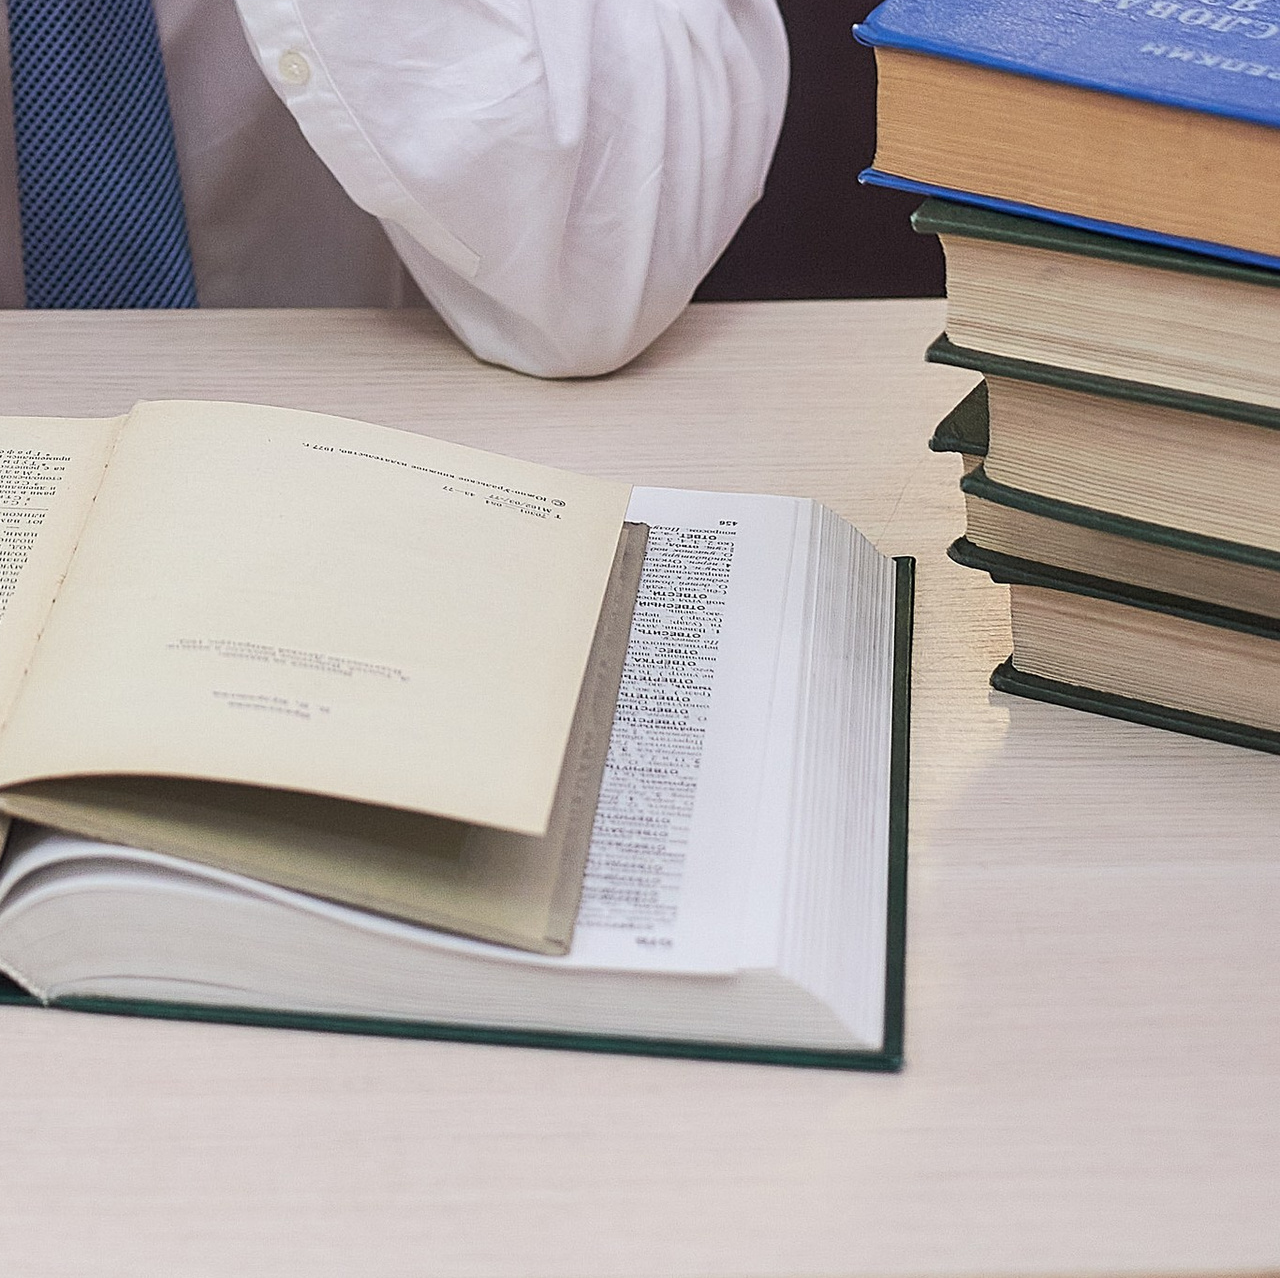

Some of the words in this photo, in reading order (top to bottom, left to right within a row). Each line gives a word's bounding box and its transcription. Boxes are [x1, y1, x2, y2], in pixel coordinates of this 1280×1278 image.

[312, 444, 335, 453] 1977
[338, 448, 408, 467] издательство,
[410, 464, 455, 479] книжное
[458, 476, 547, 502] Южно-Уральское
